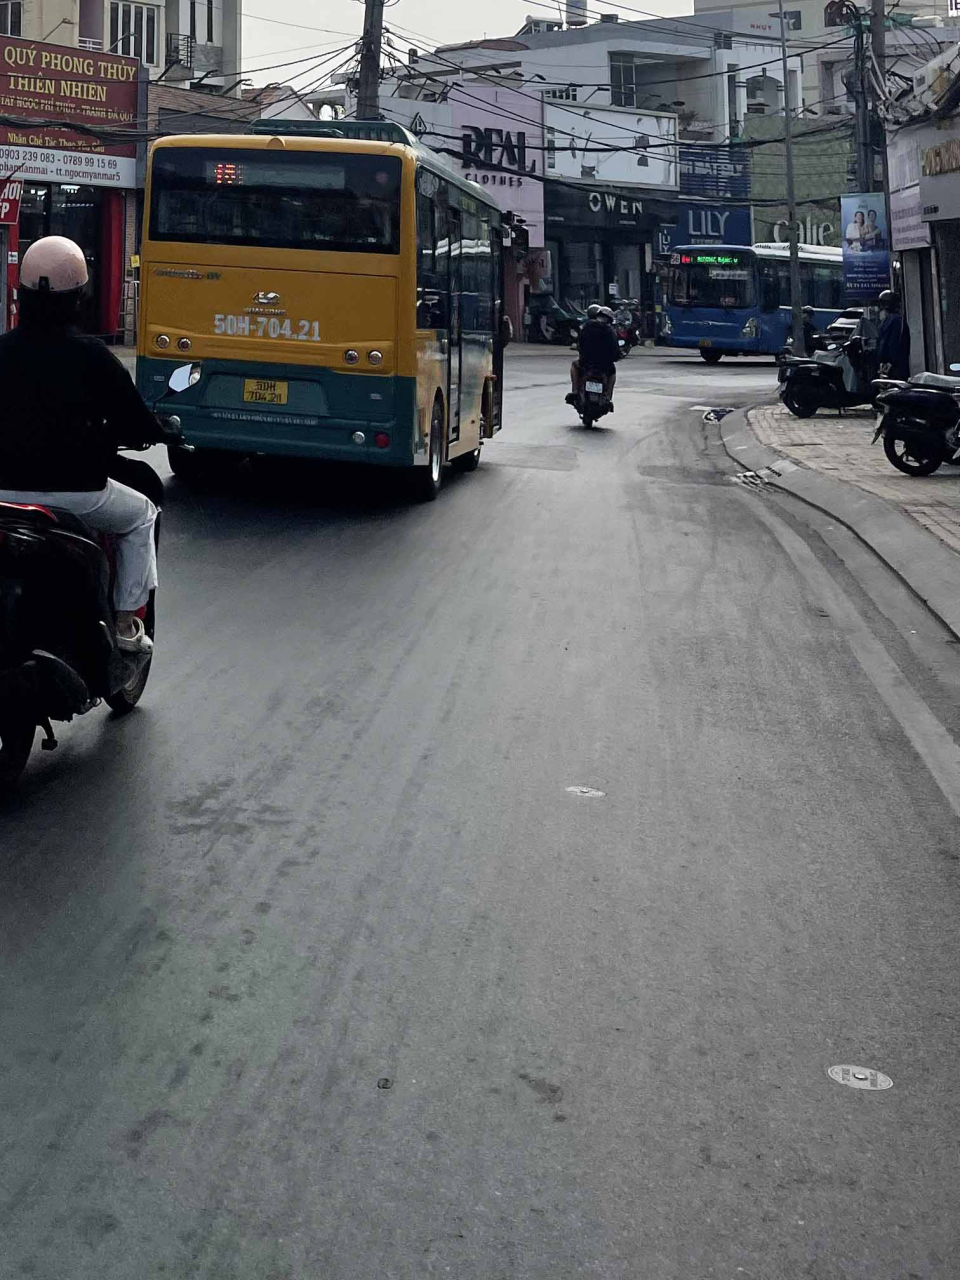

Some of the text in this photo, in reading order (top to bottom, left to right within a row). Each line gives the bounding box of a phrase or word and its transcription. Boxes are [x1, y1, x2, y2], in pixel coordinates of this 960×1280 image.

[4, 45, 37, 67] QUÝ
[41, 52, 94, 75] PHONG
[98, 59, 136, 82] THỦY
[7, 71, 107, 102] THIÊN NHIÊN
[0, 148, 20, 161] 0903
[23, 152, 38, 163] 239
[40, 153, 55, 164] 083
[63, 156, 83, 167] 0789
[84, 158, 95, 168] 99
[97, 159, 107, 169] 15
[107, 159, 117, 170] 69
[461, 125, 536, 173] REAL
[55, 167, 121, 181] tt.ngocmyanmar5
[465, 173, 523, 187] CLOTHES
[589, 192, 643, 214] OWEN
[688, 209, 730, 236] LILY
[214, 314, 321, 341] 50H-704.21
